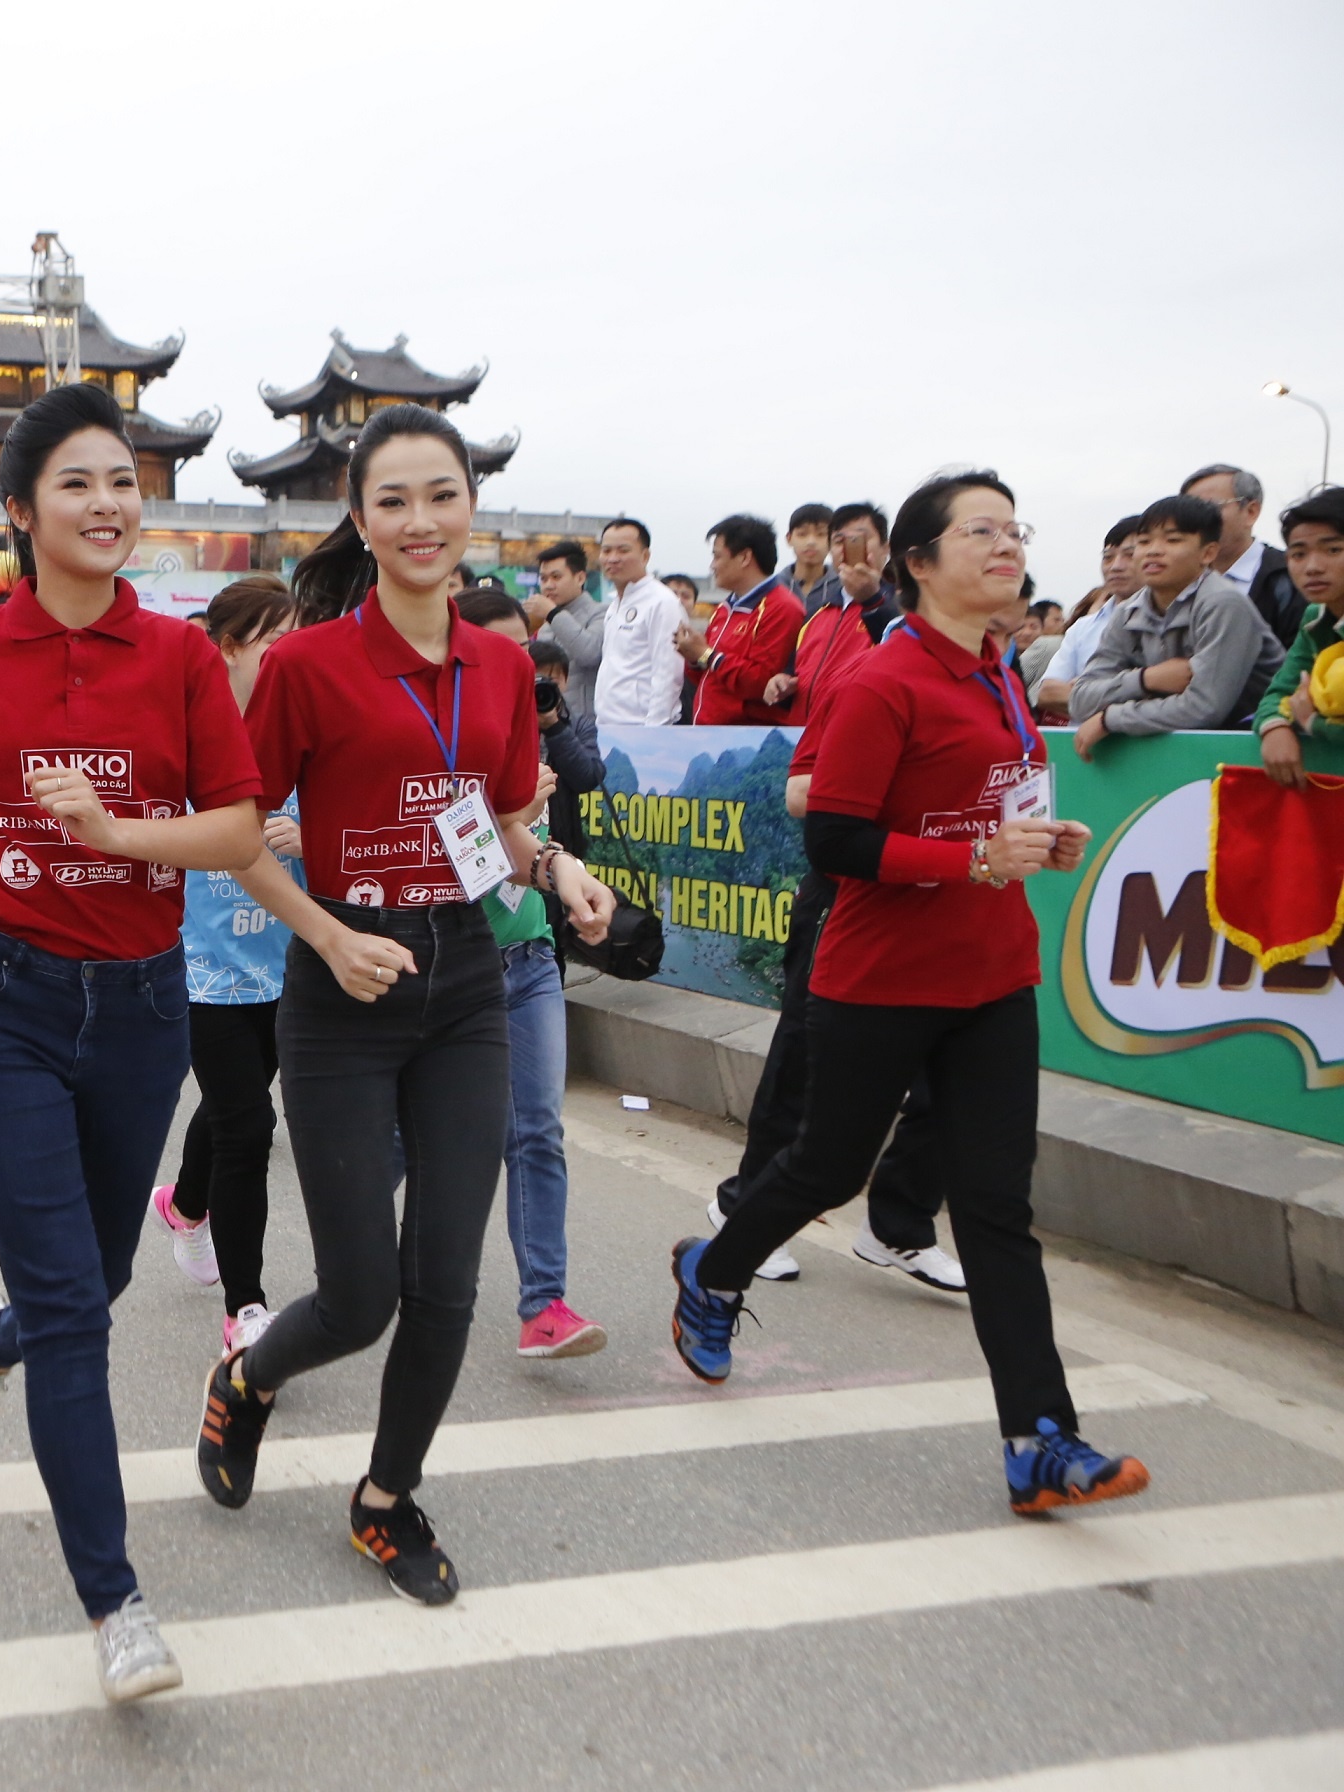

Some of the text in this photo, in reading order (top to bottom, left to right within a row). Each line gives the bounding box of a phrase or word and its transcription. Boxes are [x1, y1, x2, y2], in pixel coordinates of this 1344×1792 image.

[91, 779, 127, 789] CAO CẤP
[420, 801, 436, 812] LÀM
[446, 800, 474, 823] DAIKIO
[611, 791, 746, 853] COMPLEX
[345, 840, 423, 859] AGRIBANK
[433, 887, 464, 896] HYUND
[671, 874, 795, 944] HERITAG
[232, 907, 278, 937] 60+
